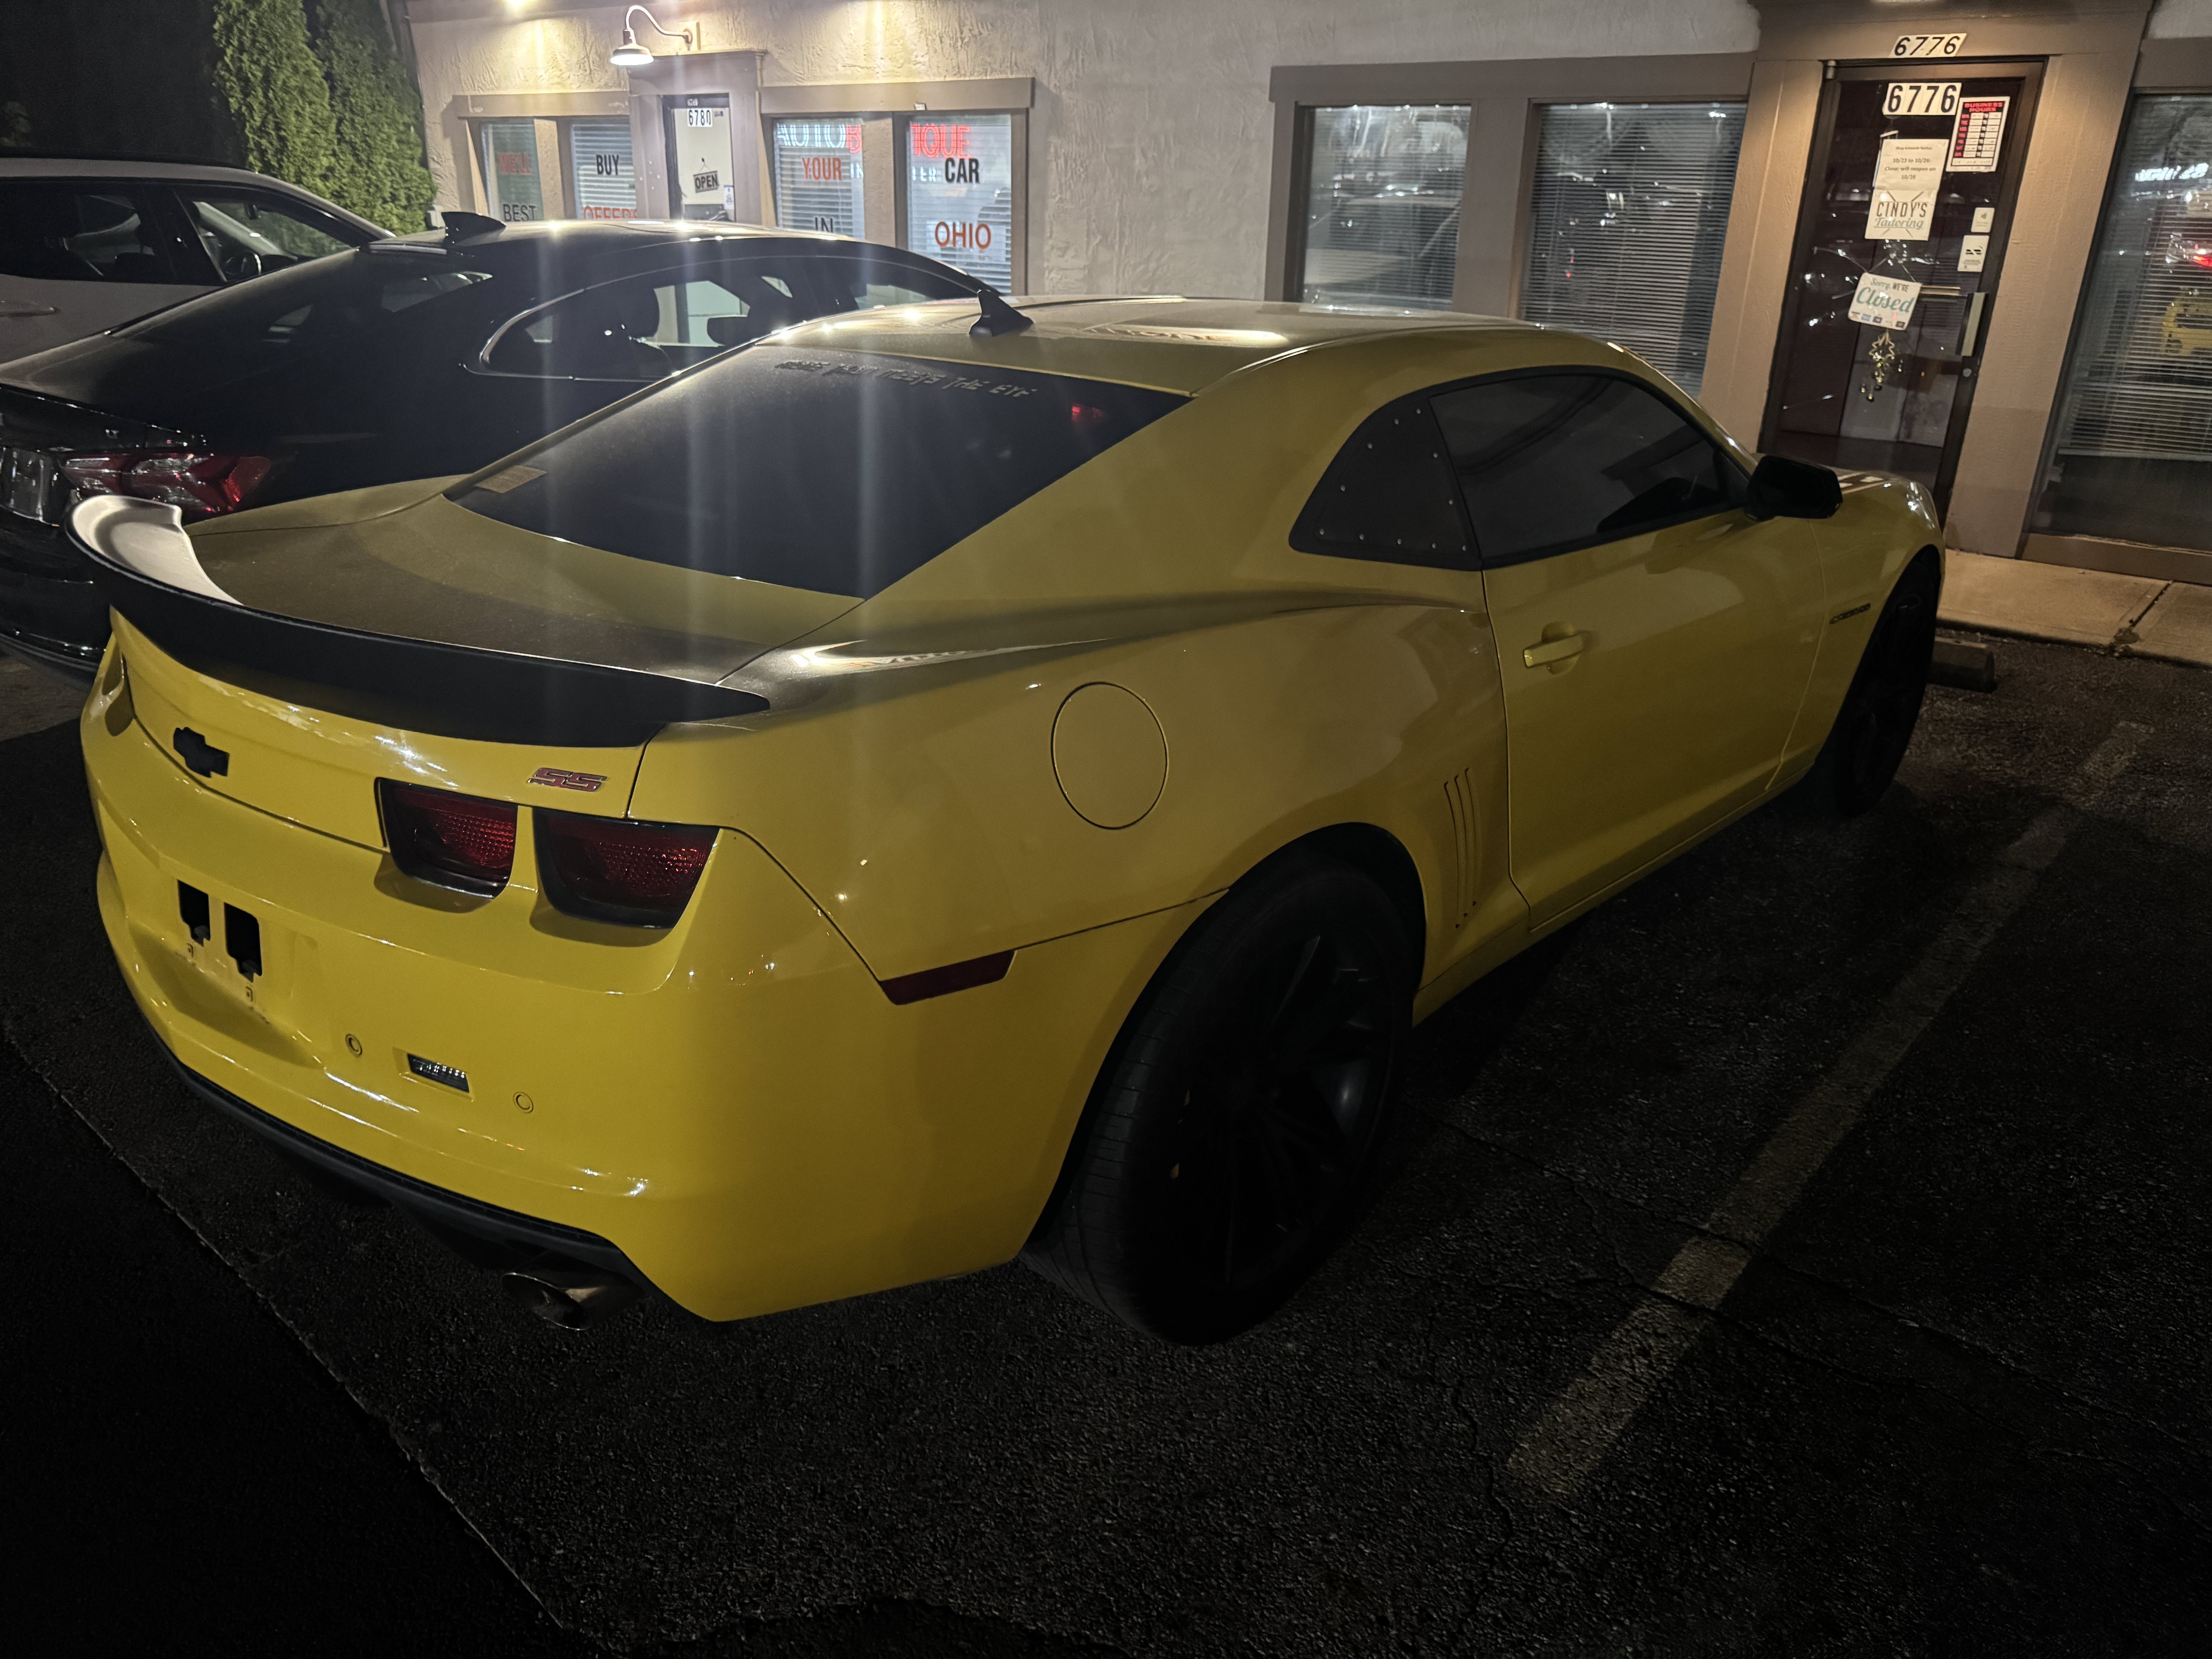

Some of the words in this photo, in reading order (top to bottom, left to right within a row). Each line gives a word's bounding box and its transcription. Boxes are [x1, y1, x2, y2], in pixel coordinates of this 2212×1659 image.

[1894, 35, 1960, 56] 6776
[1887, 85, 1957, 113] 6776
[689, 110, 711, 125] 6780
[596, 154, 619, 175] BUY
[802, 157, 842, 180] YOUR
[945, 158, 979, 183] CAR
[696, 174, 719, 189] OPEN
[503, 204, 536, 221] BEST
[1876, 202, 1927, 217] CINDY'S
[815, 217, 833, 232] IN
[1875, 217, 1923, 229] Tailoring
[935, 222, 991, 249] OHIO
[1856, 287, 1915, 313] Closed
[942, 377, 990, 390] THE
[989, 385, 1038, 397] EYE
[526, 767, 608, 792] SS
